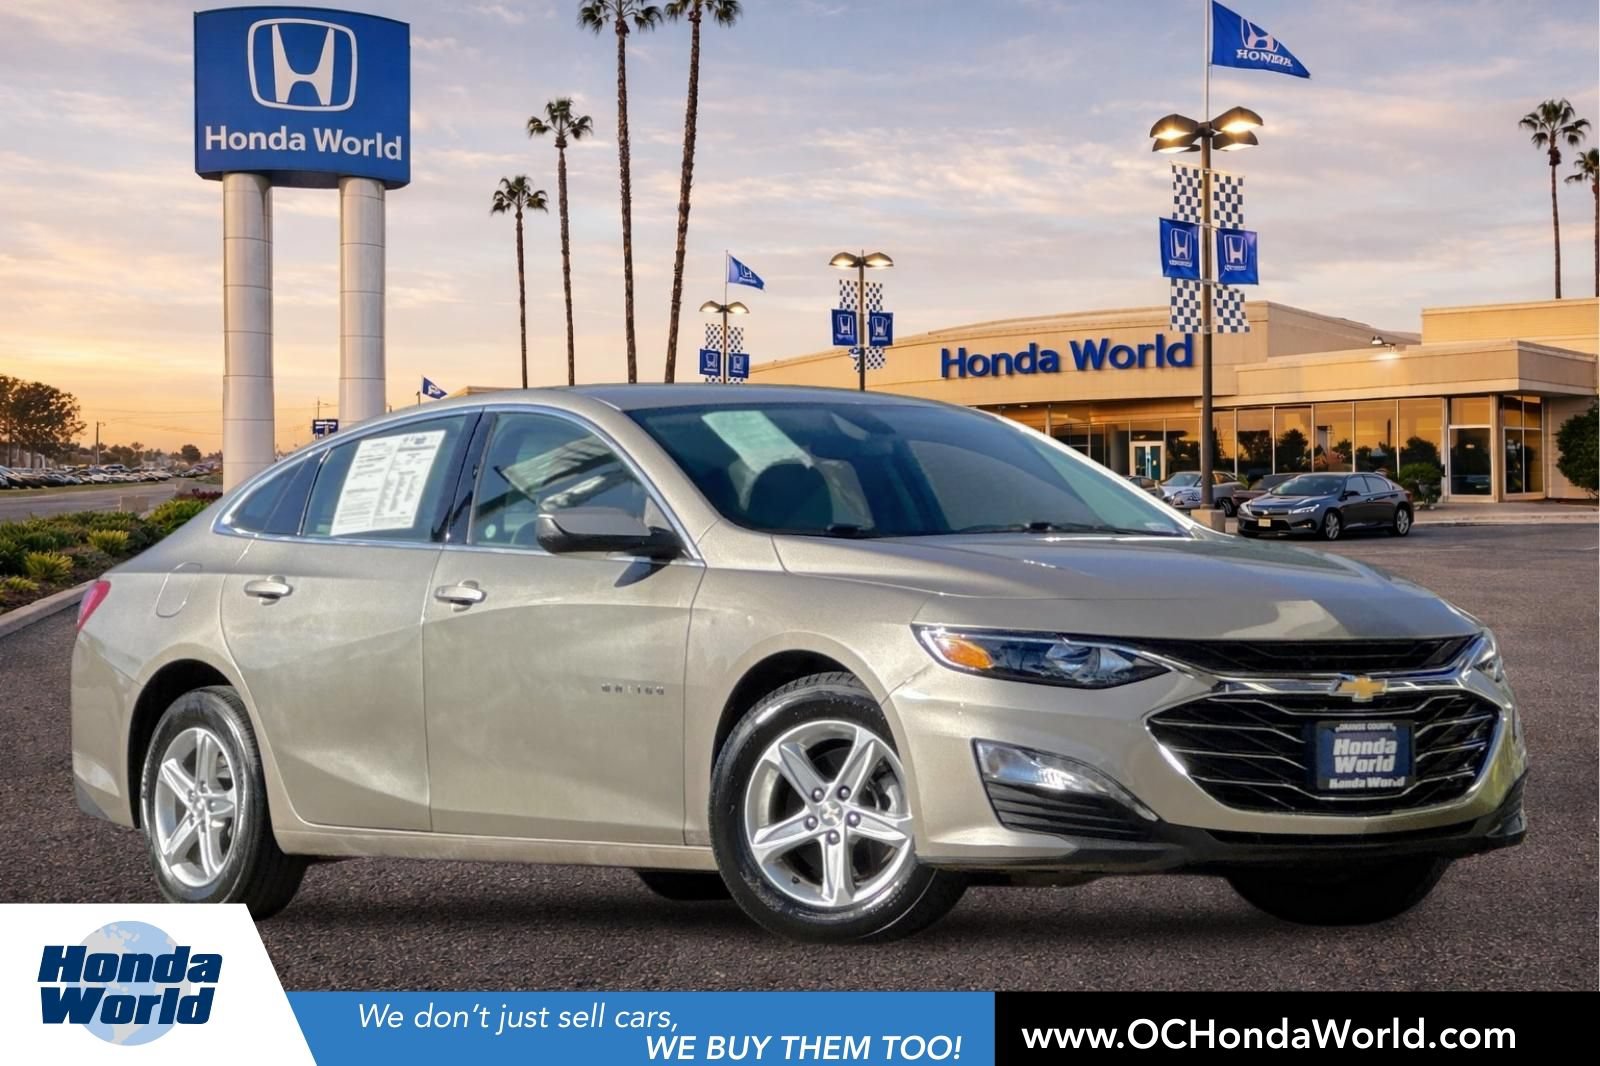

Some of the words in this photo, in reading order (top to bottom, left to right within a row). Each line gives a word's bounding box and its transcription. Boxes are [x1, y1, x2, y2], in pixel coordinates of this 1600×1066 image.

[205, 125, 305, 151] Honda
[313, 128, 402, 160] World
[941, 342, 1061, 378] Honda
[1069, 333, 1194, 371] World
[1333, 737, 1397, 756] Honda
[1335, 755, 1396, 773] World
[1329, 778, 1365, 789] Honda
[1367, 776, 1405, 788] World
